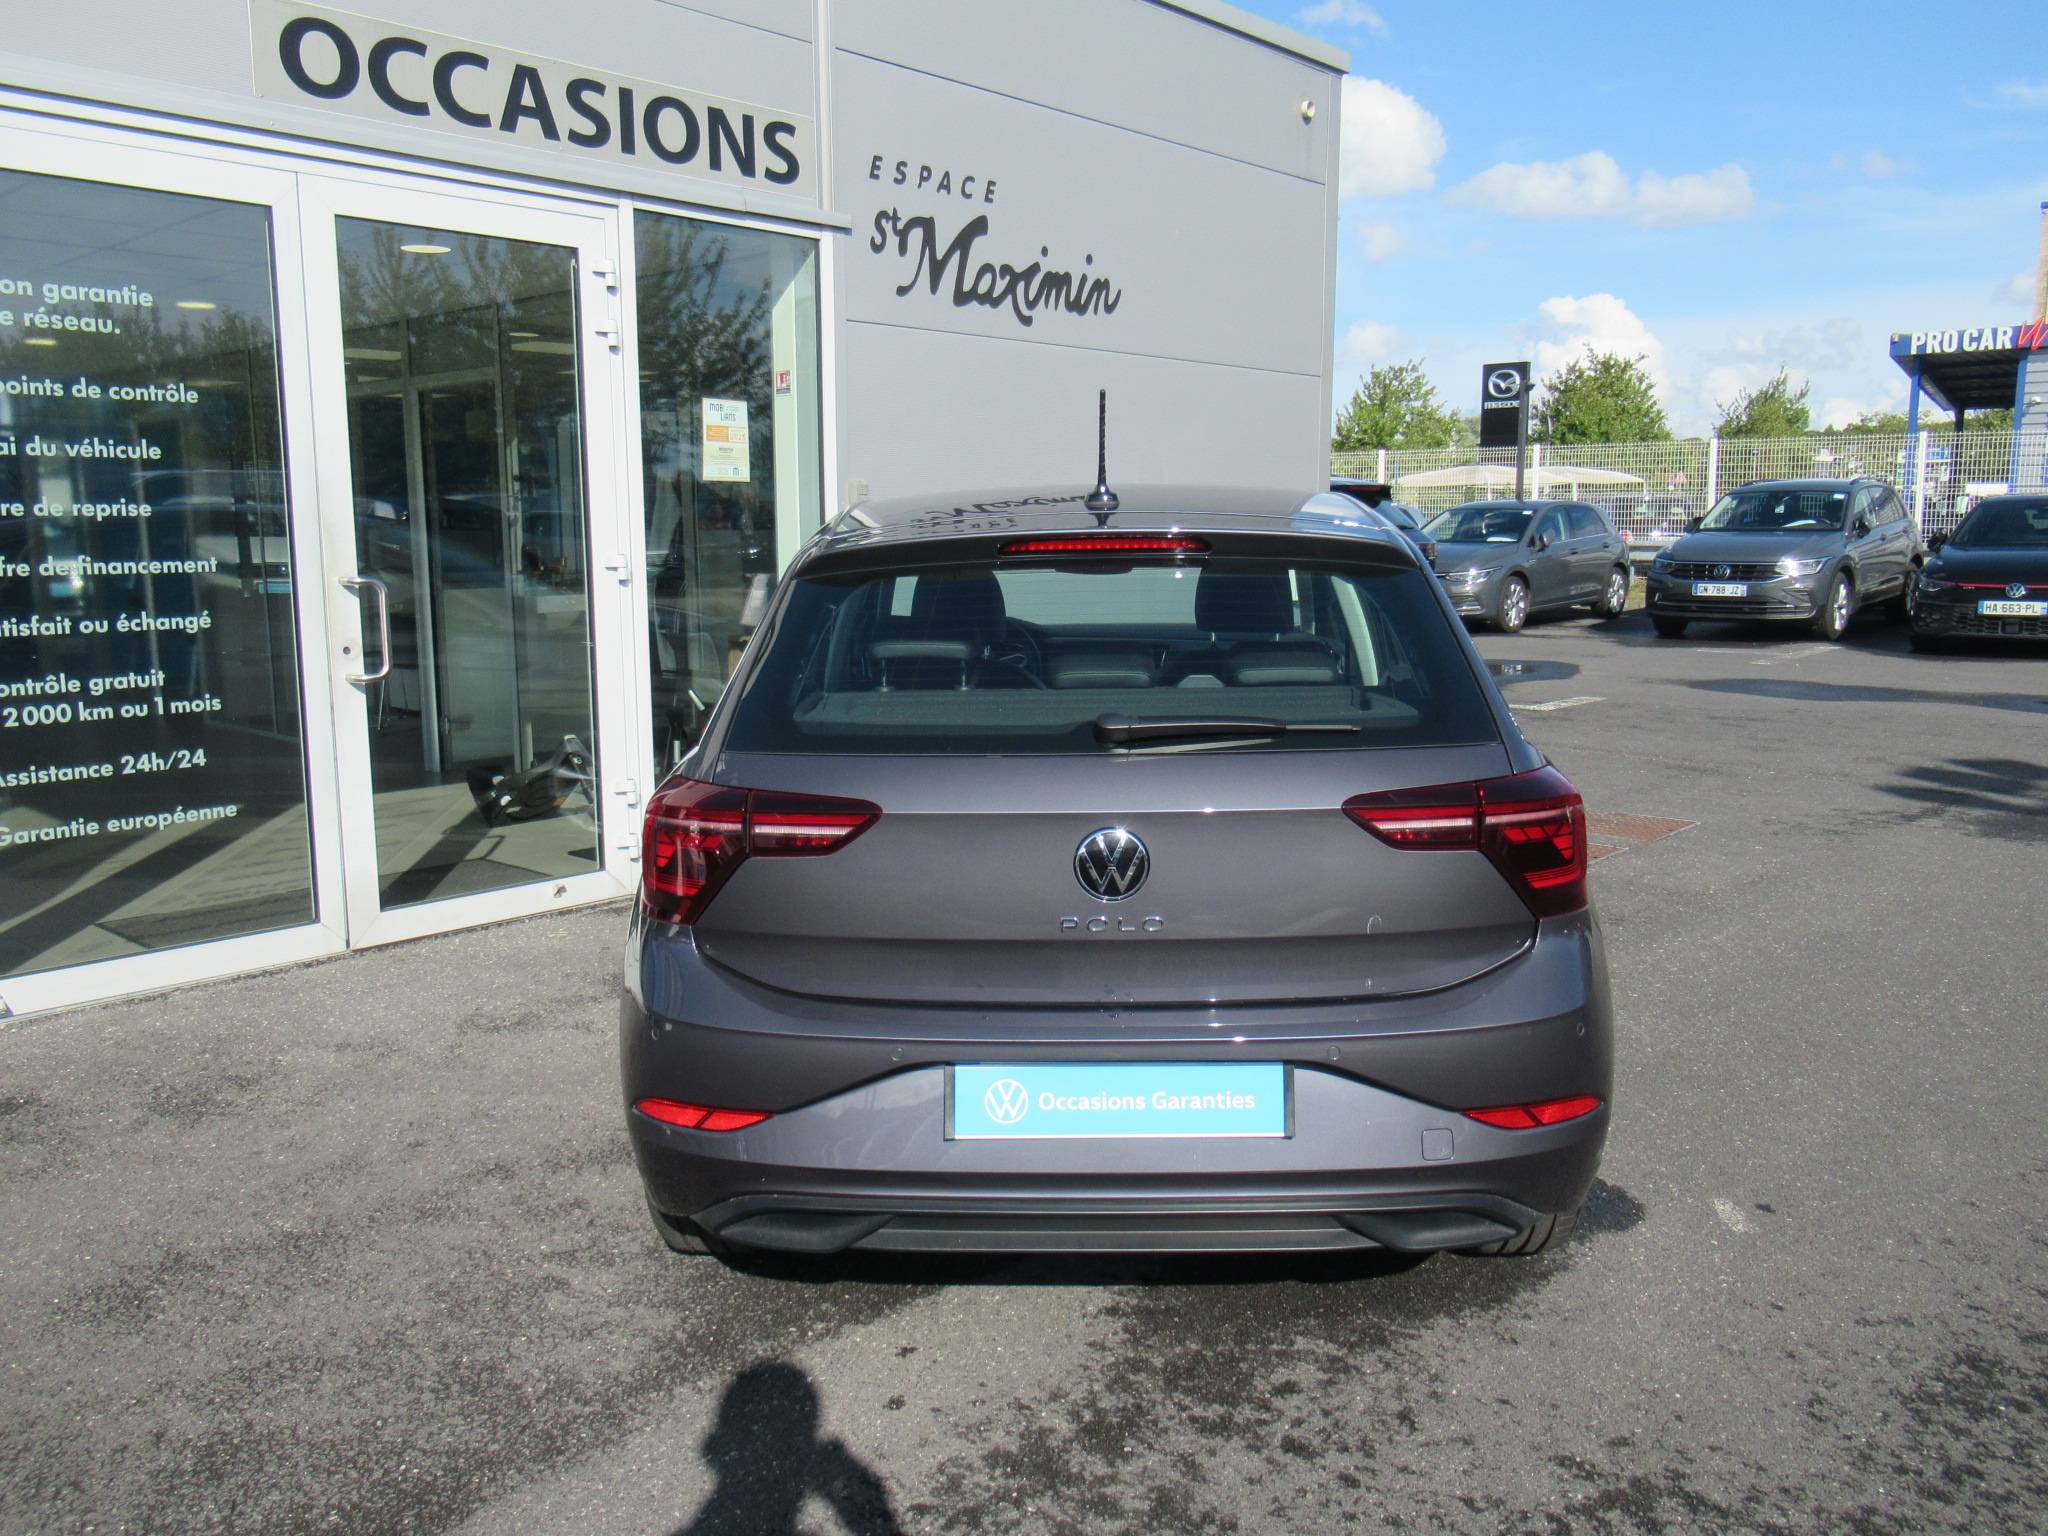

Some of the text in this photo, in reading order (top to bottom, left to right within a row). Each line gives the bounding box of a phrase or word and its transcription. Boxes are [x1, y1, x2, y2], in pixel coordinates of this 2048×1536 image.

[279, 16, 800, 185] OCCASIONS
[869, 154, 997, 203] ESPACE
[896, 214, 1122, 327] Maximin
[0, 279, 153, 306] on garantie
[24, 306, 121, 334] réseau.
[1910, 326, 2013, 355] PRO CAR
[71, 376, 102, 399] de
[108, 382, 199, 404] contrôle
[25, 435, 57, 456] du
[64, 437, 162, 460] véhicule
[33, 496, 65, 517] de
[72, 498, 152, 521] reprise
[39, 555, 70, 576] de
[77, 555, 218, 577] financement
[0, 610, 212, 637] tisfait ou échangé
[89, 669, 165, 696] gratuit
[78, 701, 114, 722] km
[120, 704, 149, 718] ou
[154, 696, 164, 715] 1
[170, 693, 222, 714] mois
[120, 748, 207, 776] 24h/24
[0, 803, 238, 847] Garantie européenne
[1060, 914, 1165, 933] POLO
[1038, 1091, 1146, 1111] Occasions
[1151, 1090, 1256, 1110] Garanties
